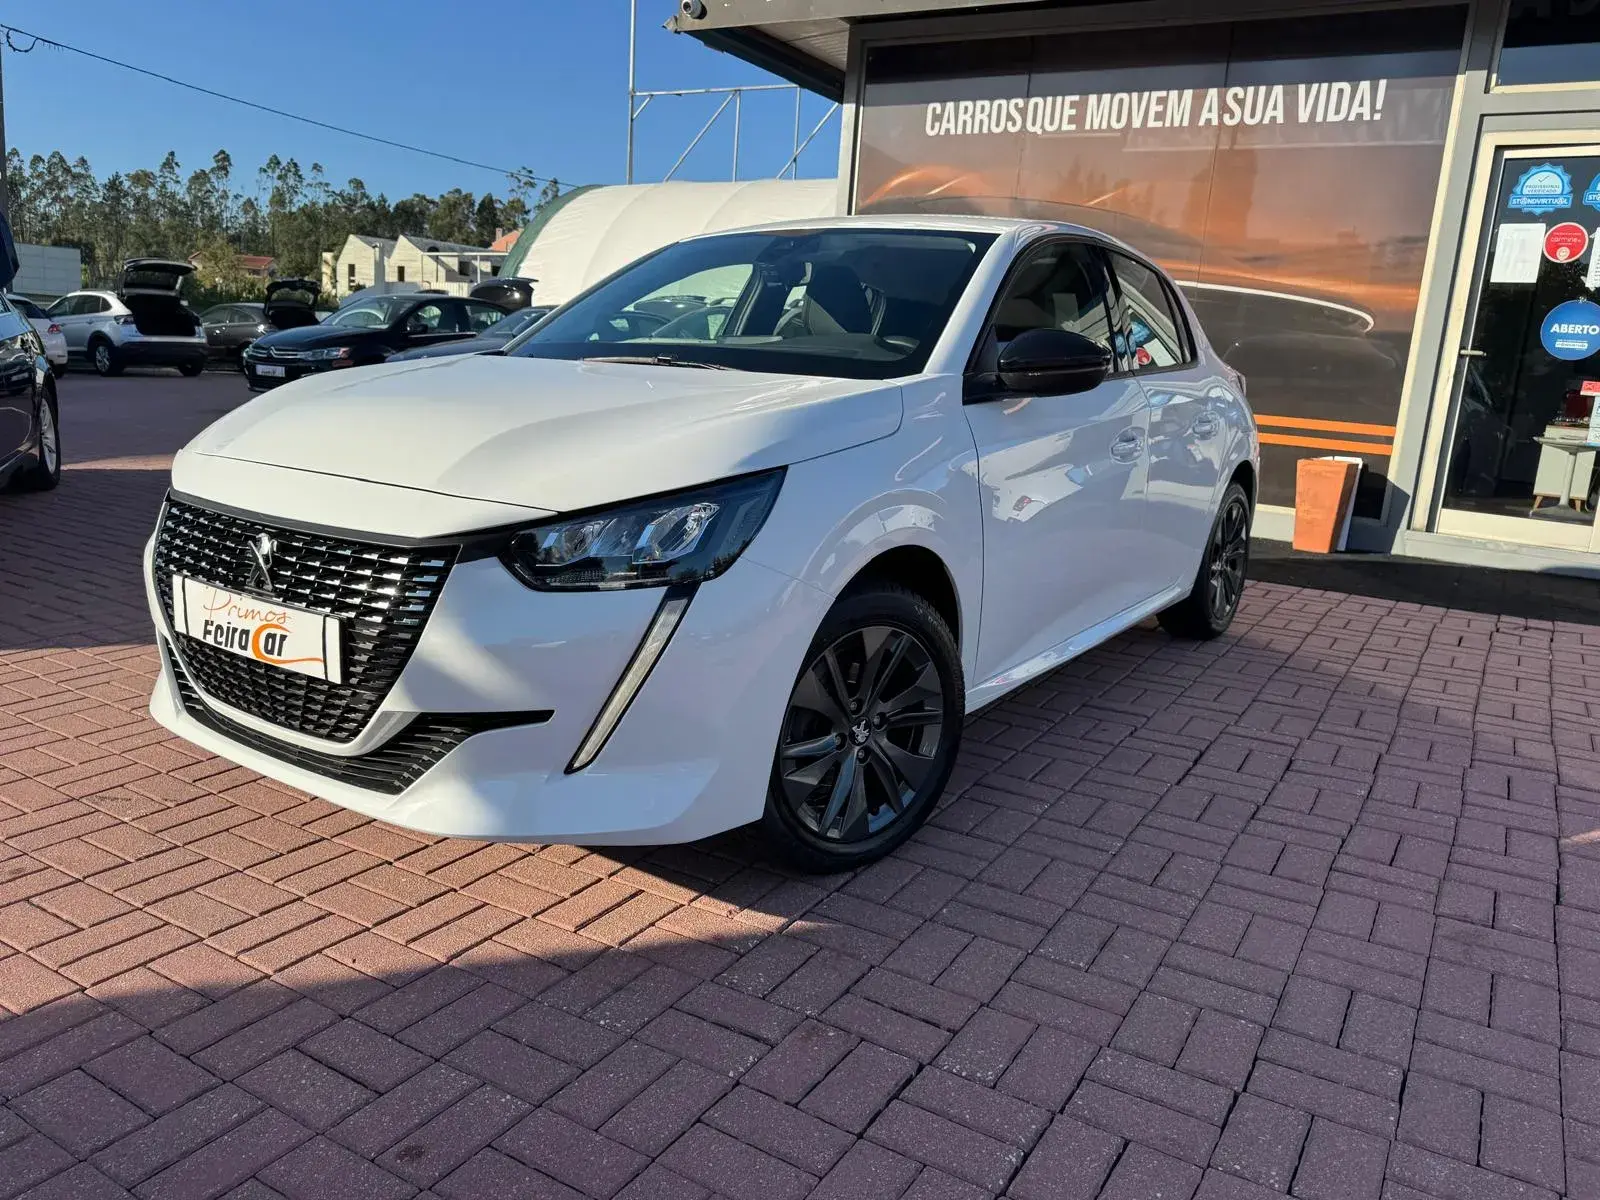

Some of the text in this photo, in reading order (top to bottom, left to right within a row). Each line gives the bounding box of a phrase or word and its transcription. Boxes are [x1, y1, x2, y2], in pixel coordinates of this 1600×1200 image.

[925, 78, 1388, 137] CARROS QUE MOVEM A SUA VIDA!
[1550, 322, 1600, 335] ABERTO
[203, 587, 292, 625] Primos
